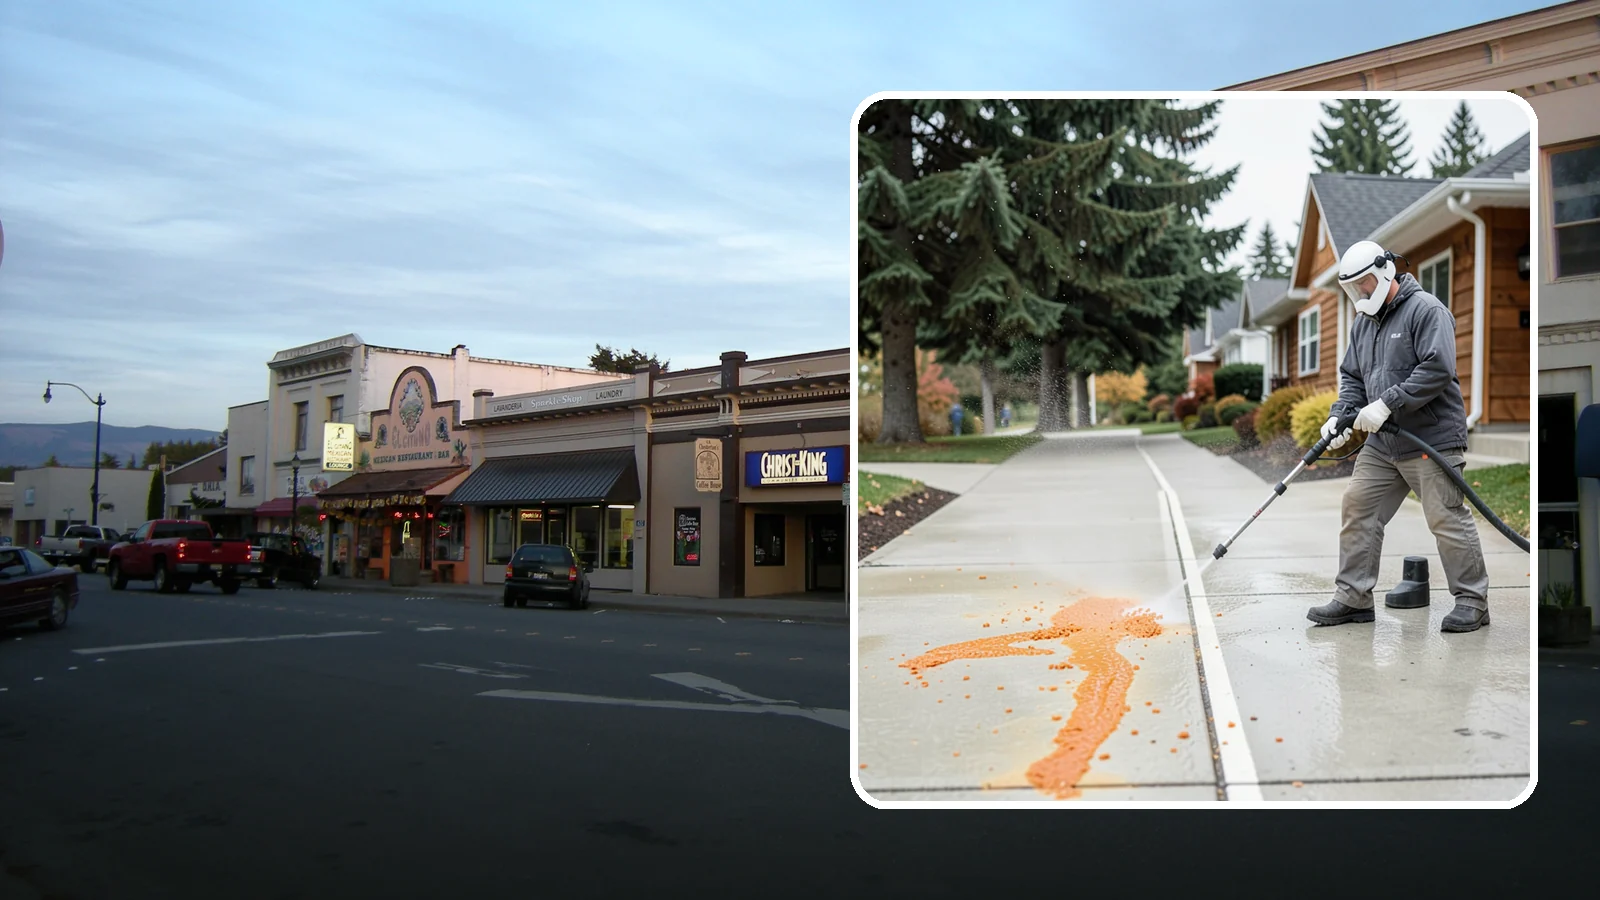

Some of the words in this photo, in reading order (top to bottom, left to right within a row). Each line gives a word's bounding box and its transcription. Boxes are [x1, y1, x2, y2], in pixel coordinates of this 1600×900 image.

[493, 402, 523, 412] LAVANDERIA
[531, 398, 560, 409] Sparkle
[562, 394, 583, 405] Shop
[596, 388, 624, 400] LAUNDRY
[373, 454, 396, 464] MEXICAN
[397, 451, 433, 462] RESTAURANT
[438, 450, 450, 459] BAR
[761, 452, 797, 477] CHRIST
[799, 450, 827, 476] KING
